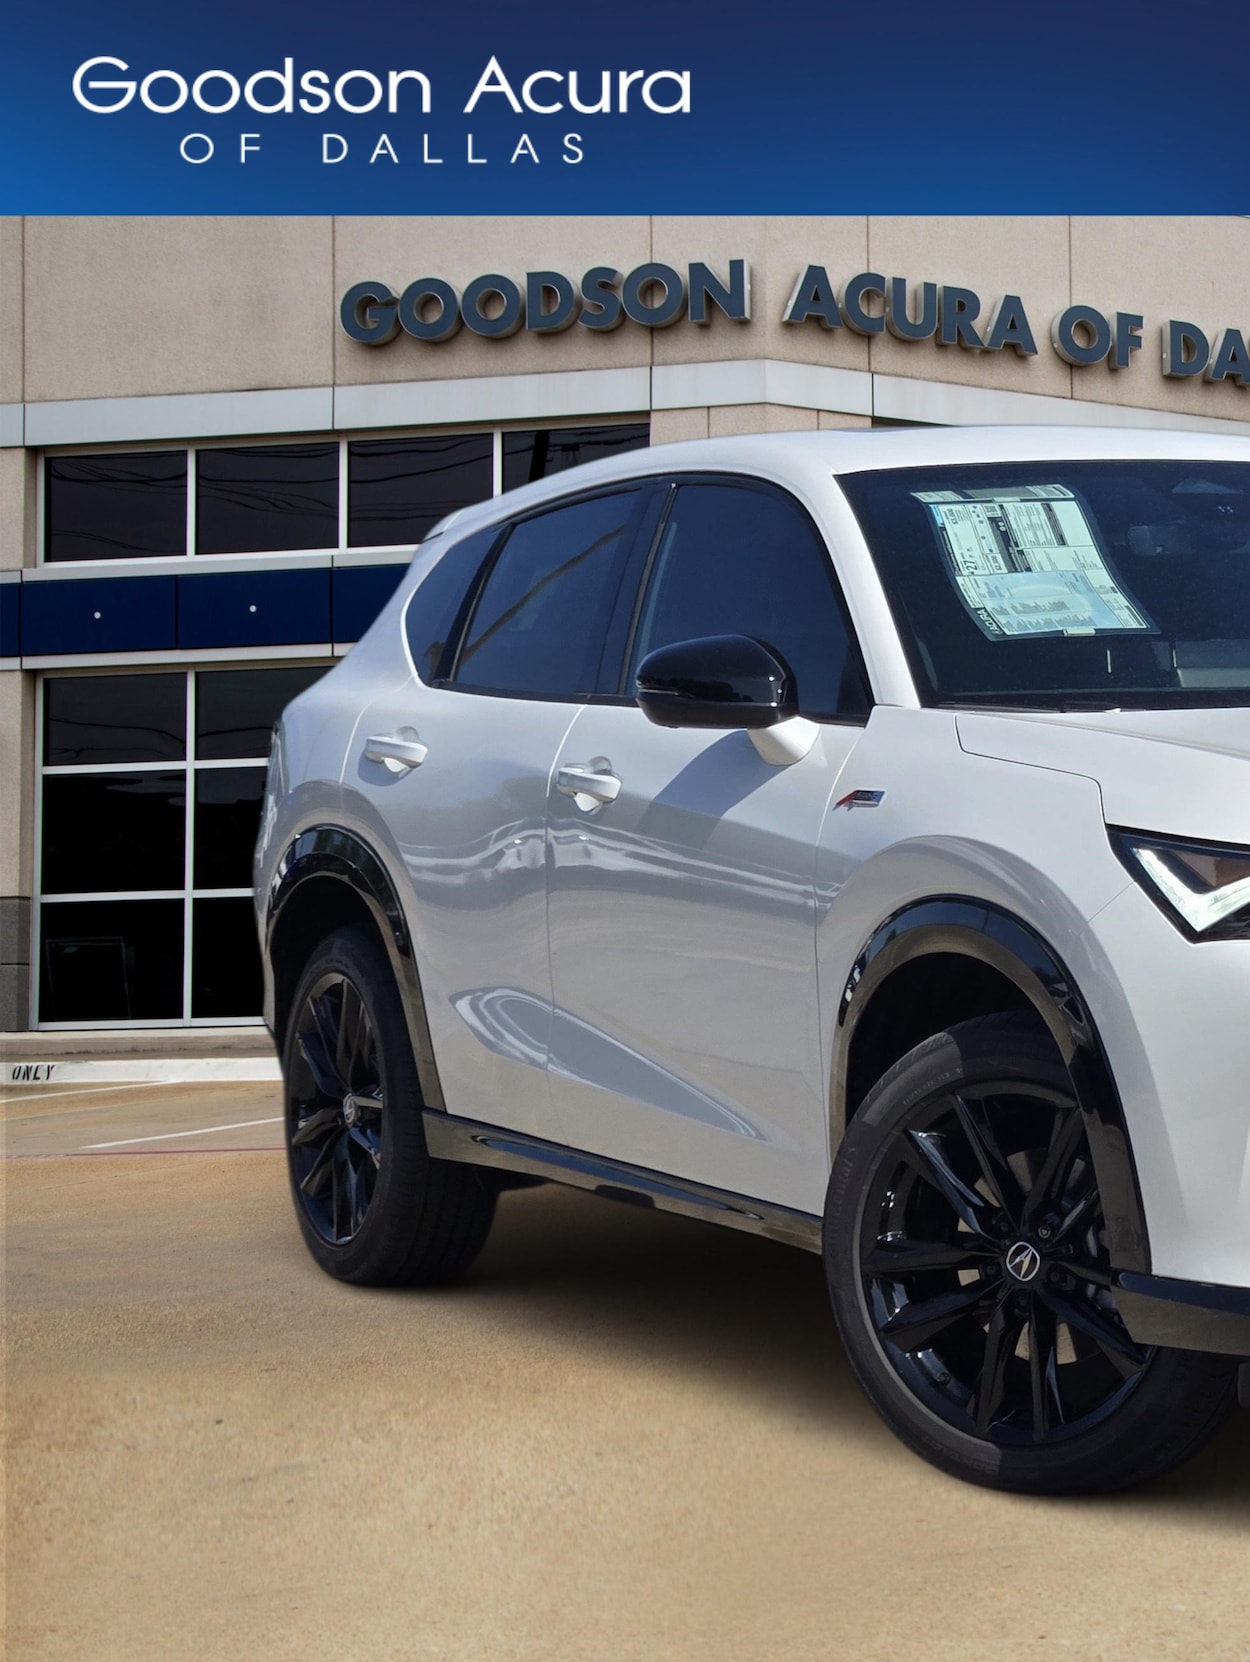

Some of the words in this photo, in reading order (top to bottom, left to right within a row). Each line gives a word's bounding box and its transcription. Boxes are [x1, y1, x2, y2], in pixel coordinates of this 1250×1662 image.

[340, 259, 751, 346] GOODSON
[782, 264, 1038, 356] ACURA
[1051, 304, 1144, 370] OF
[11, 1064, 55, 1081] ONLY
